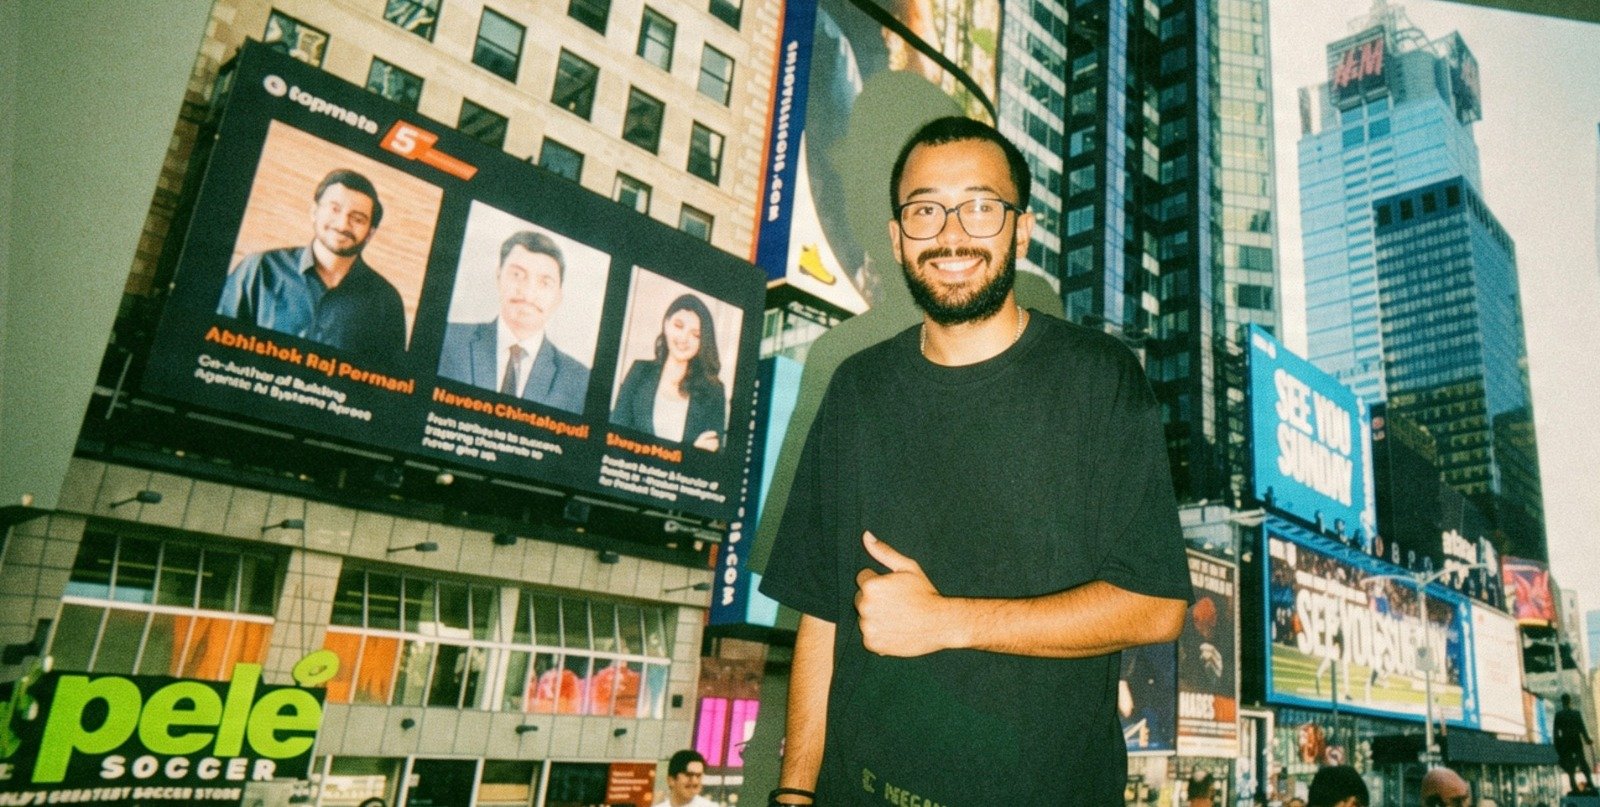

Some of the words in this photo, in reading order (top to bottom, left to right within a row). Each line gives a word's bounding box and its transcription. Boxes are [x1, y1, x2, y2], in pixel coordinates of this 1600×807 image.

[289, 85, 379, 135] topmate
[390, 126, 419, 155] 5
[1274, 368, 1314, 436] SEE
[100, 755, 277, 781] SOCCER
